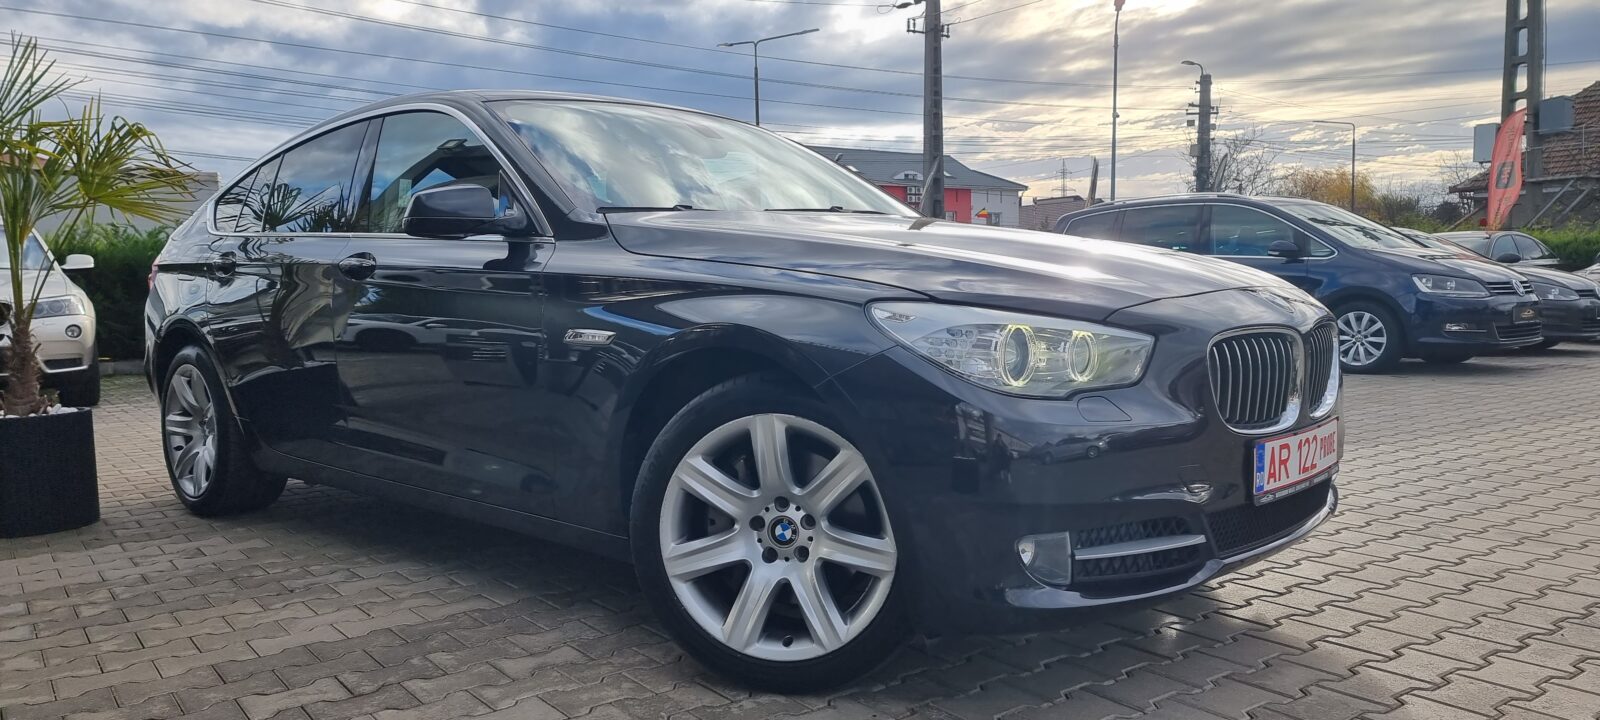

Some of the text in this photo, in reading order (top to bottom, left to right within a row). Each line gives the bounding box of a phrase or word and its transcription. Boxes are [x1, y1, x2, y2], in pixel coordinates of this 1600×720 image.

[1267, 432, 1336, 485] AR 122 PROBE
